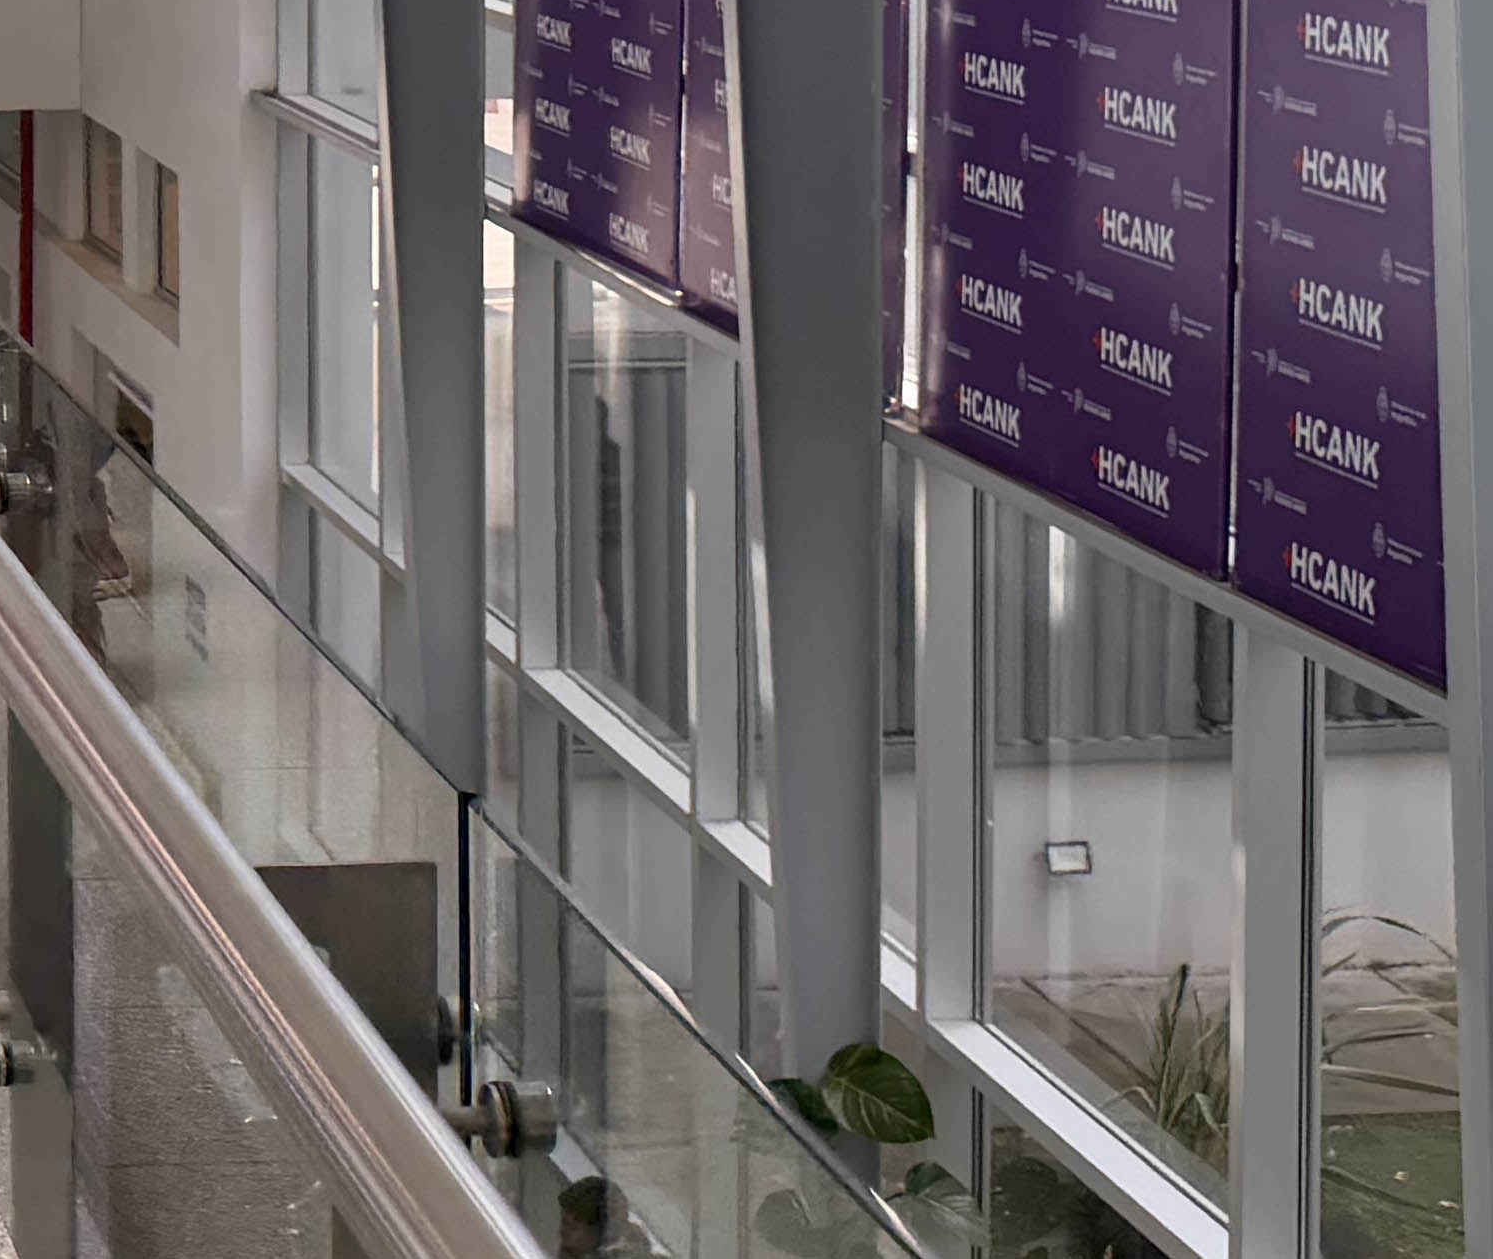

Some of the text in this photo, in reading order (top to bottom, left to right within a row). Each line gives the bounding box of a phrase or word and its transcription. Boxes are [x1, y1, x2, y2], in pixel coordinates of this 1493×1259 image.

[537, 13, 573, 44] HCANK
[1305, 13, 1390, 67] HCANK
[611, 37, 652, 74] HCANK
[964, 51, 1025, 98] HCANK
[536, 98, 571, 129] HCANK
[1104, 86, 1176, 139] HCANK
[610, 129, 652, 165] HCANK
[534, 179, 571, 213] HCANK
[963, 162, 1024, 212] HCANK
[1302, 145, 1387, 204] HCANK
[610, 216, 652, 255] HCANK
[1102, 206, 1175, 262] HCANK
[961, 274, 1022, 327] HCANK
[1299, 277, 1384, 341] HCANK
[1100, 327, 1172, 388] HCANK
[959, 383, 1020, 440] HCANK
[1295, 411, 1380, 480] HCANK
[1098, 445, 1170, 511] HCANK
[1291, 542, 1375, 616] HCANK
